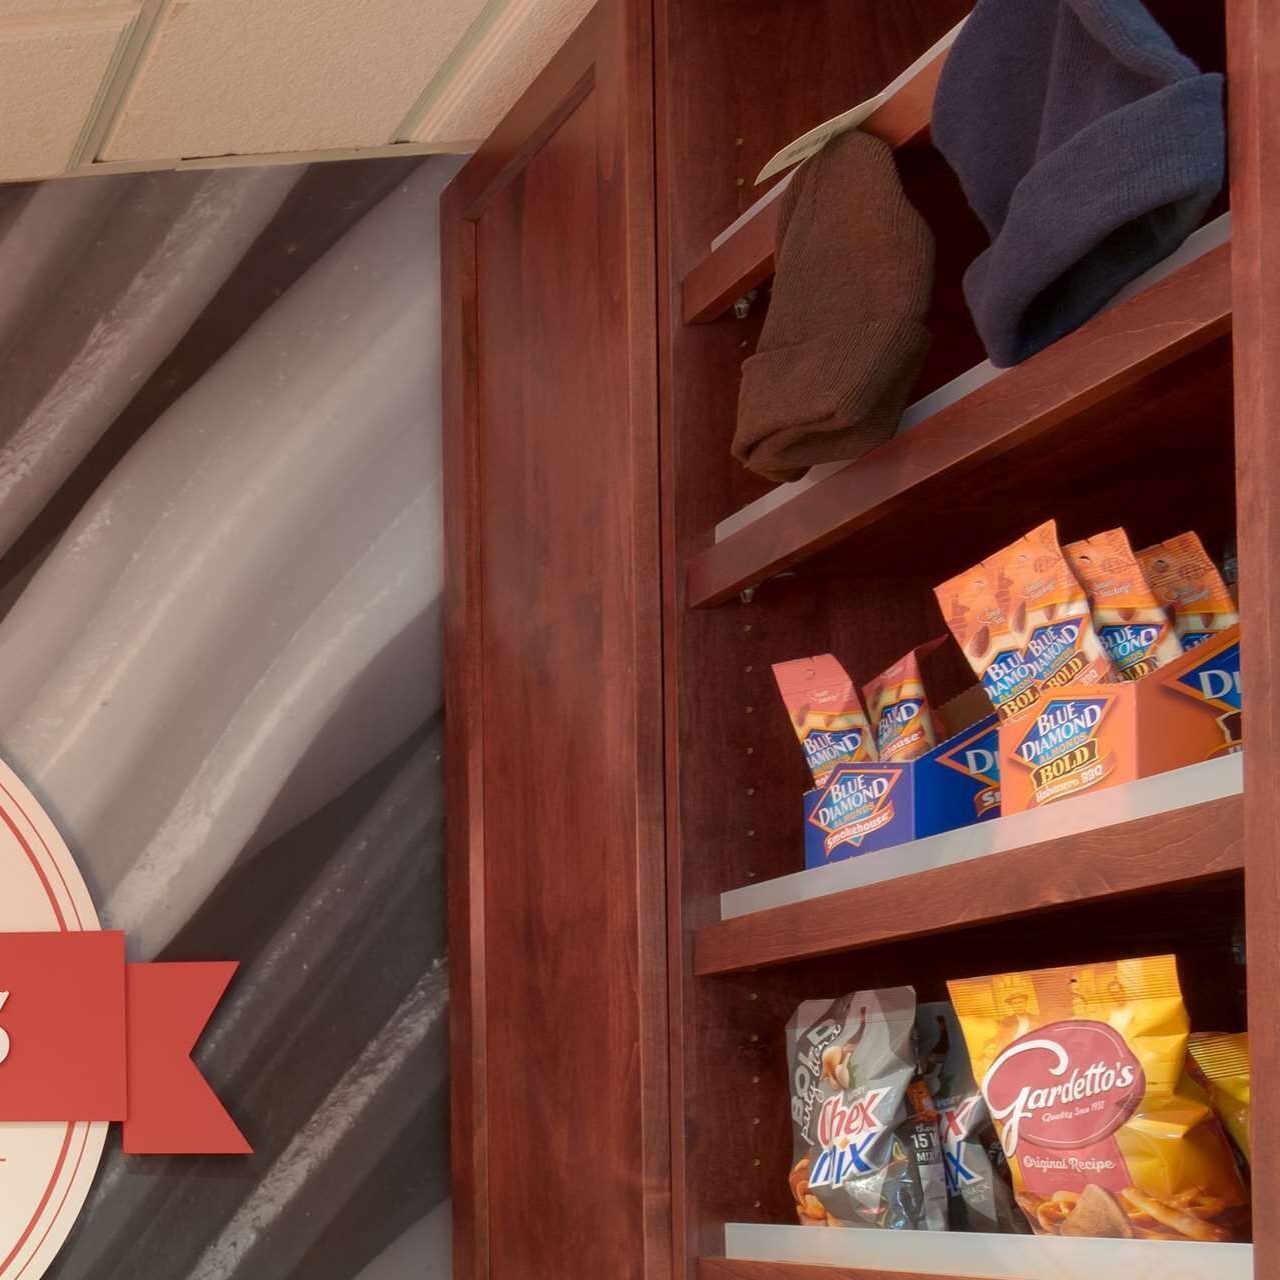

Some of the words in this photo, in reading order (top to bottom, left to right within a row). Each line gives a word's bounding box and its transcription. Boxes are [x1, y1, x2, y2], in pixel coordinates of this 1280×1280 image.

[1022, 704, 1102, 764] DIAMOND
[1037, 702, 1079, 737] BLUE
[804, 732, 835, 755] BLUE
[805, 732, 863, 769] IAMOND
[1039, 732, 1089, 765] ALMONDS
[1036, 777, 1080, 802] Habanero
[1080, 764, 1105, 785] BBQ
[1039, 746, 1091, 786] BOLD
[818, 777, 890, 827] DIAMOND
[829, 774, 867, 805] BLUE
[826, 811, 891, 849] Smokehouse
[832, 801, 875, 830] ALMONDS
[982, 1039, 1135, 1160] Gardetto's
[1042, 1111, 1073, 1123] Quality
[818, 1088, 887, 1149] Chex
[1023, 1155, 1068, 1174] Original
[1068, 1156, 1115, 1173] Recipe
